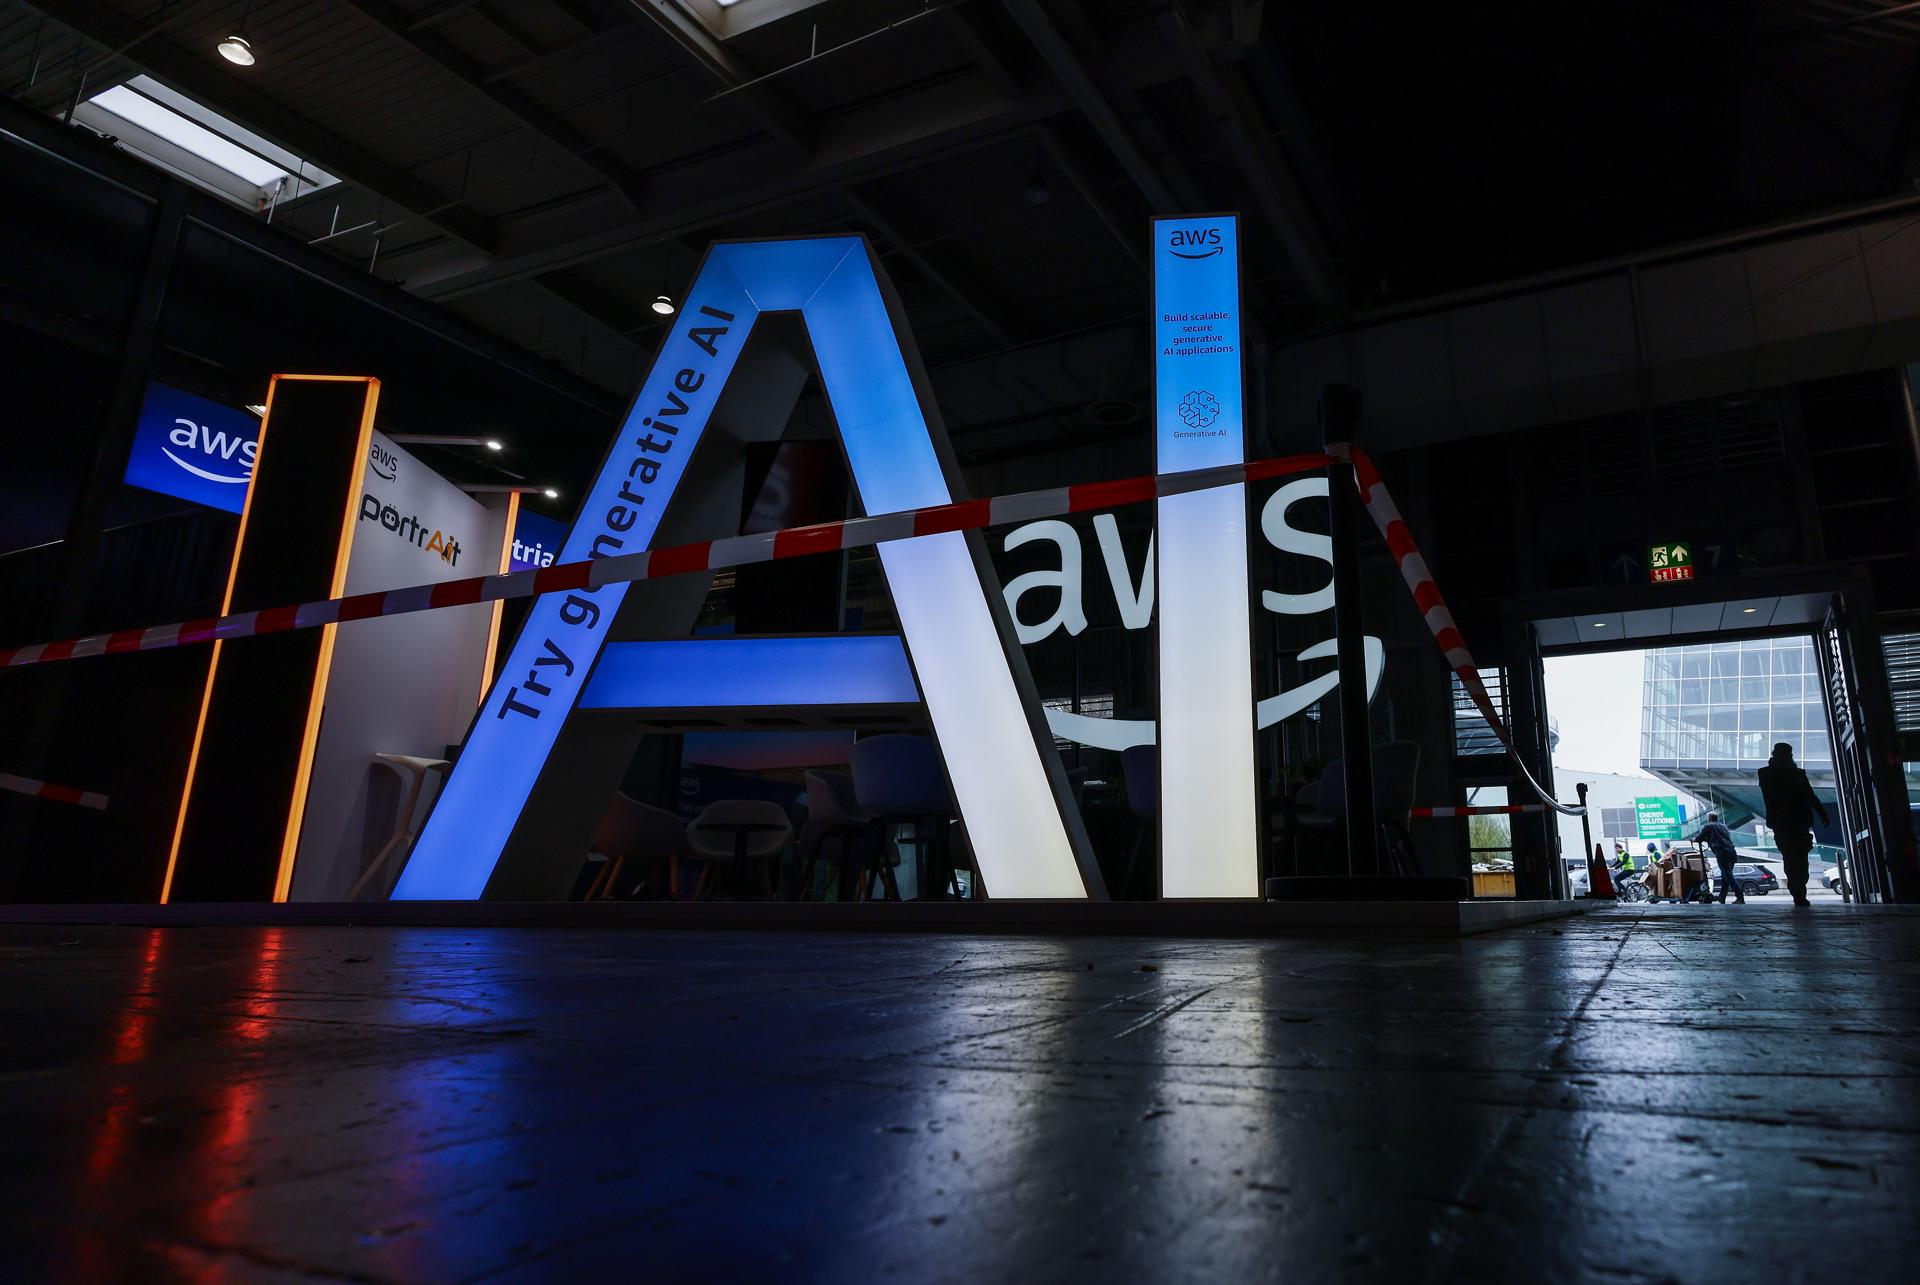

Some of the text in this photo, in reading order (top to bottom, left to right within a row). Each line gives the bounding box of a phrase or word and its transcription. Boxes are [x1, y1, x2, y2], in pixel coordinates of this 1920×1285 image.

[1170, 227, 1222, 247] aws
[1163, 311, 1232, 323] Build scalable,
[1182, 324, 1213, 333] secure
[1173, 333, 1223, 345] generative
[1163, 344, 1234, 356] AI applications
[1173, 430, 1217, 438] Generative
[168, 418, 259, 467] aws
[370, 443, 398, 472] aws
[497, 305, 736, 720] Try gnerative AI
